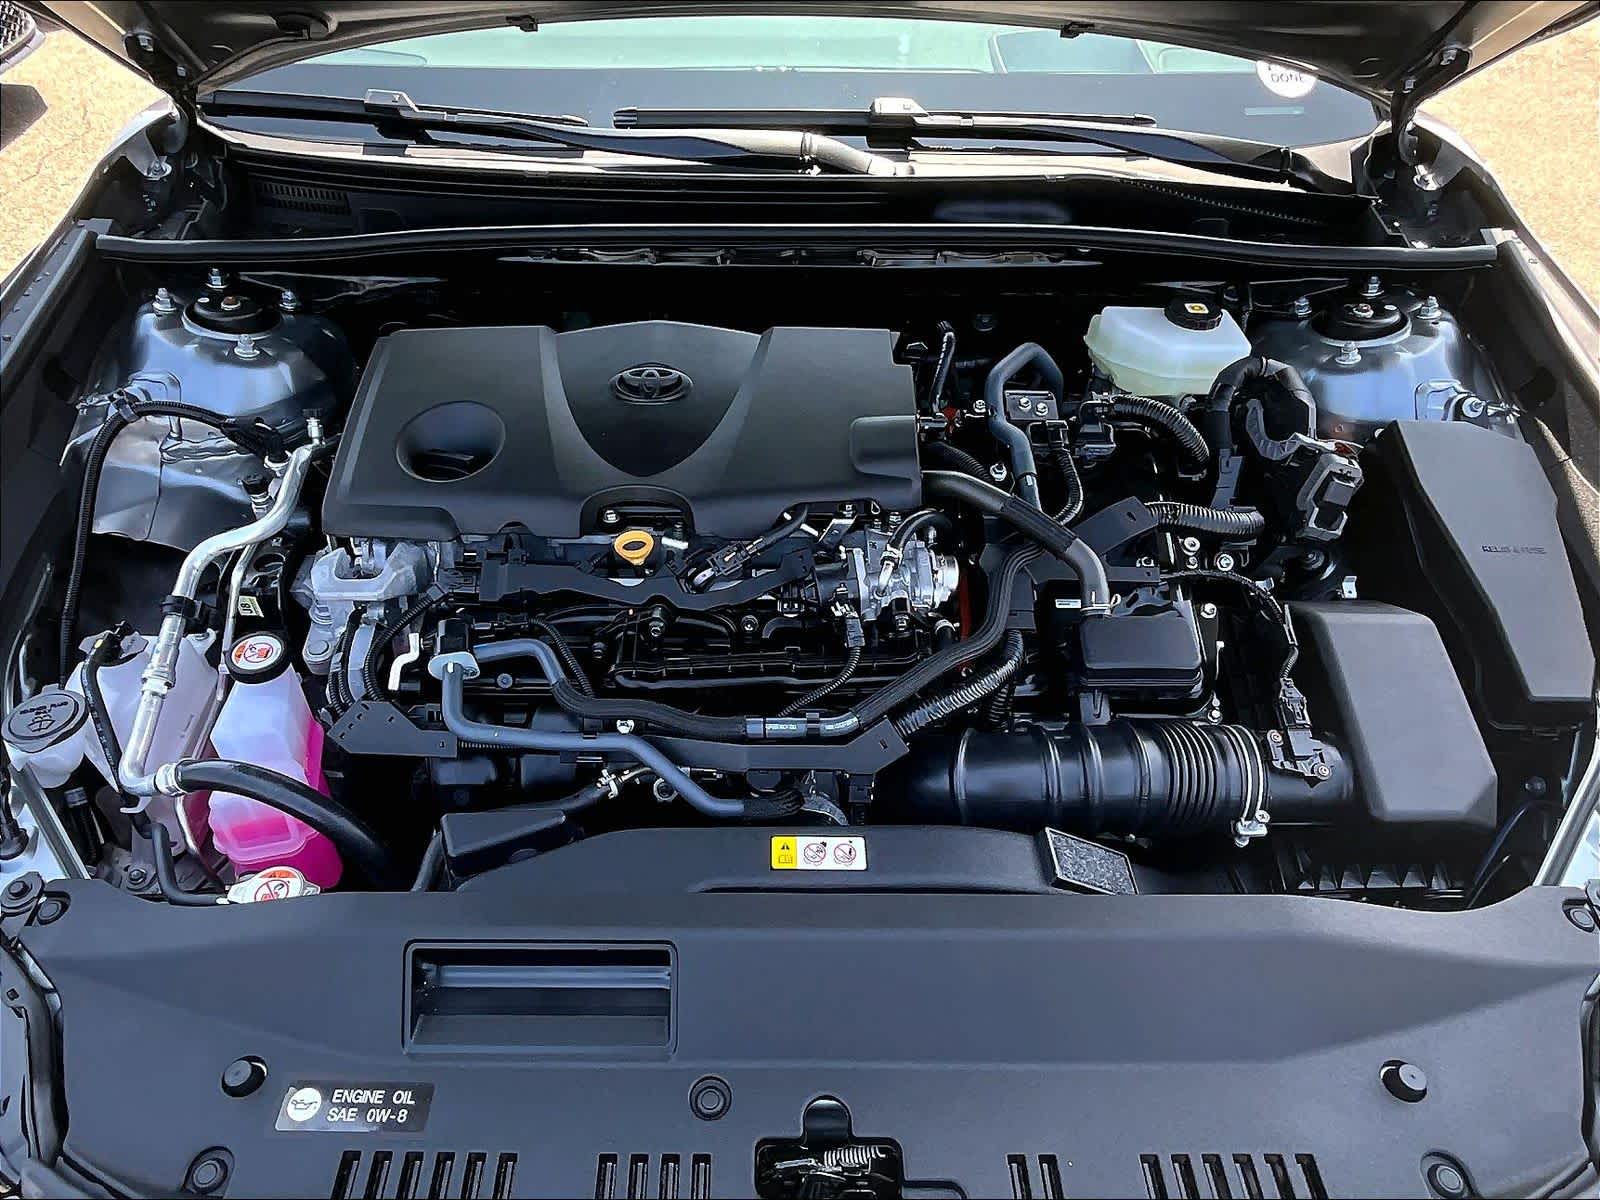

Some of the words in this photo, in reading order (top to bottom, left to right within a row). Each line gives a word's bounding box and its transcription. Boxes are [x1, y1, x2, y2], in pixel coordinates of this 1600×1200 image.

[332, 1088, 385, 1104] ENGINE
[392, 1089, 416, 1105] OIL
[326, 1108, 358, 1122] SAE
[366, 1108, 408, 1123] 0W-8
